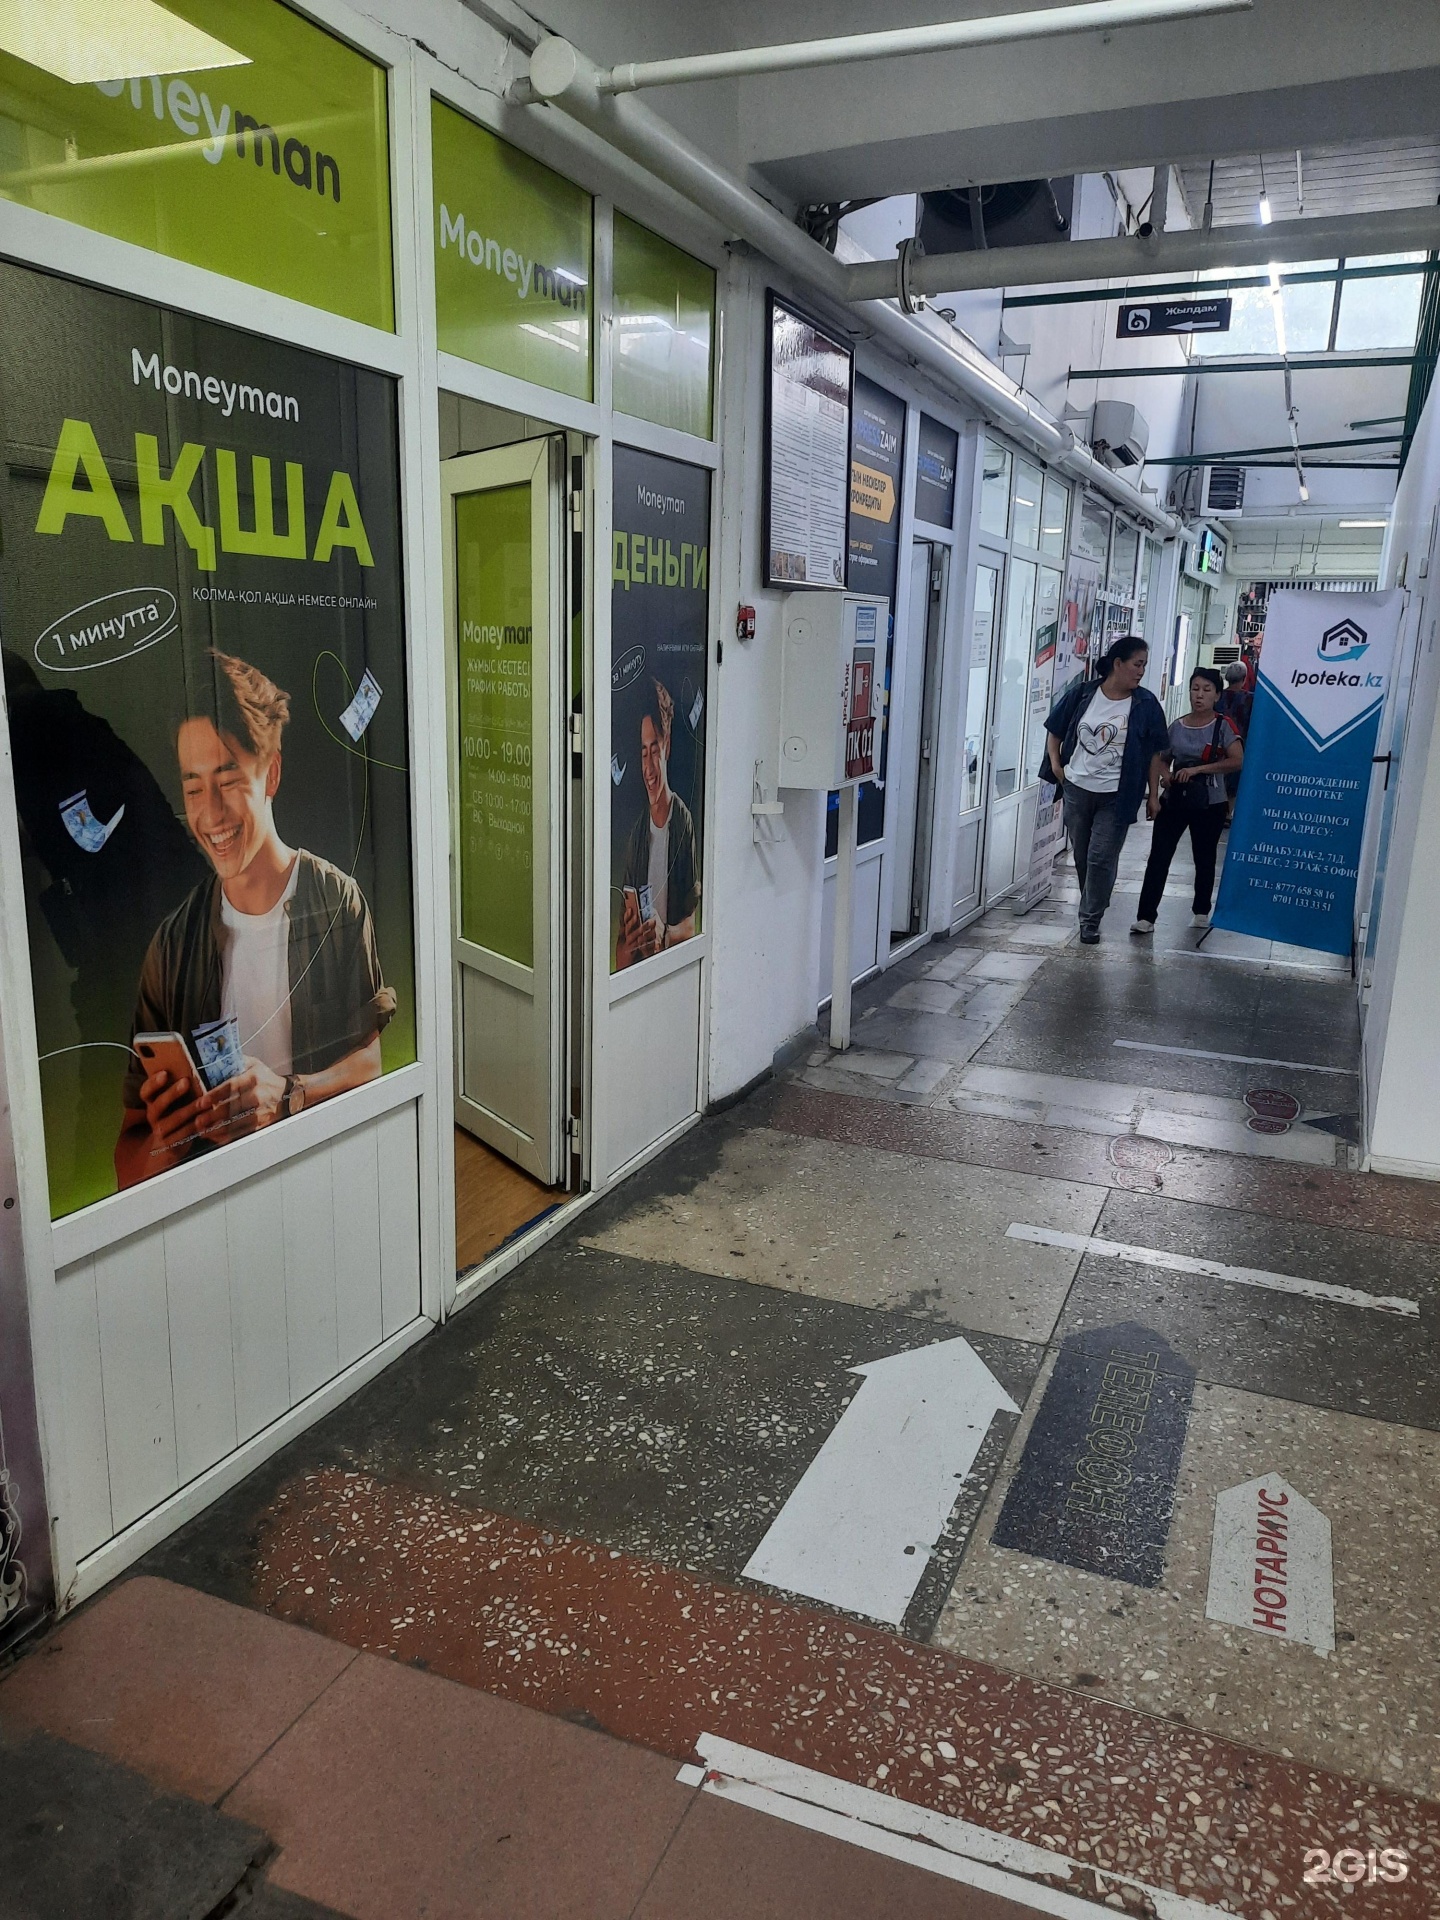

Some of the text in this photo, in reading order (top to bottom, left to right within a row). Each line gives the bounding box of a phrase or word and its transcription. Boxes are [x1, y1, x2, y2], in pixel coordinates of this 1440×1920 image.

[96, 74, 341, 203] neyman
[439, 203, 586, 315] Moneyman
[1165, 305, 1217, 316] Жылдам
[131, 347, 300, 423] Moneyman
[34, 417, 376, 572] АҚША
[637, 484, 686, 515] Moneyman
[612, 530, 708, 592] ДЕНЬГИ
[192, 586, 378, 610] ҚОЛМА-ҚОЛ АҚША НЕМЕСЕ ОНЛАЙН
[52, 632, 65, 656] 1
[497, 659, 530, 676] КЕСТЕСІ
[1290, 669, 1384, 688] Ipoteka.kz
[467, 678, 531, 698] ГРАФИК РАБОТЫ
[464, 736, 491, 760] 10.00
[501, 741, 531, 767] 19.00
[847, 727, 873, 762] ПК 01
[487, 768, 506, 784] 14.00
[512, 773, 531, 790] 15.00
[1265, 772, 1360, 790] СОПРОВОЖДЕНИЕ
[1276, 785, 1344, 801] ПО ИПОТЕКЕ
[1262, 808, 1350, 827] МЫ НАХОДИМСЯ
[1272, 821, 1334, 837] ПО АДРЕСУ:
[1231, 851, 1245, 862] ТД
[1284, 859, 1290, 868] 2
[1293, 860, 1321, 873] ЭТАЖ
[1322, 865, 1328, 874] 5
[1275, 882, 1296, 893] 8777
[1297, 885, 1312, 896] 658
[1313, 888, 1323, 898] 58
[1325, 890, 1335, 900] 16
[1272, 894, 1331, 912] 8701 133 33 51
[1066, 1349, 1160, 1520] ТЕЛЕФОН
[1252, 1488, 1289, 1632] НОТАРИУС
